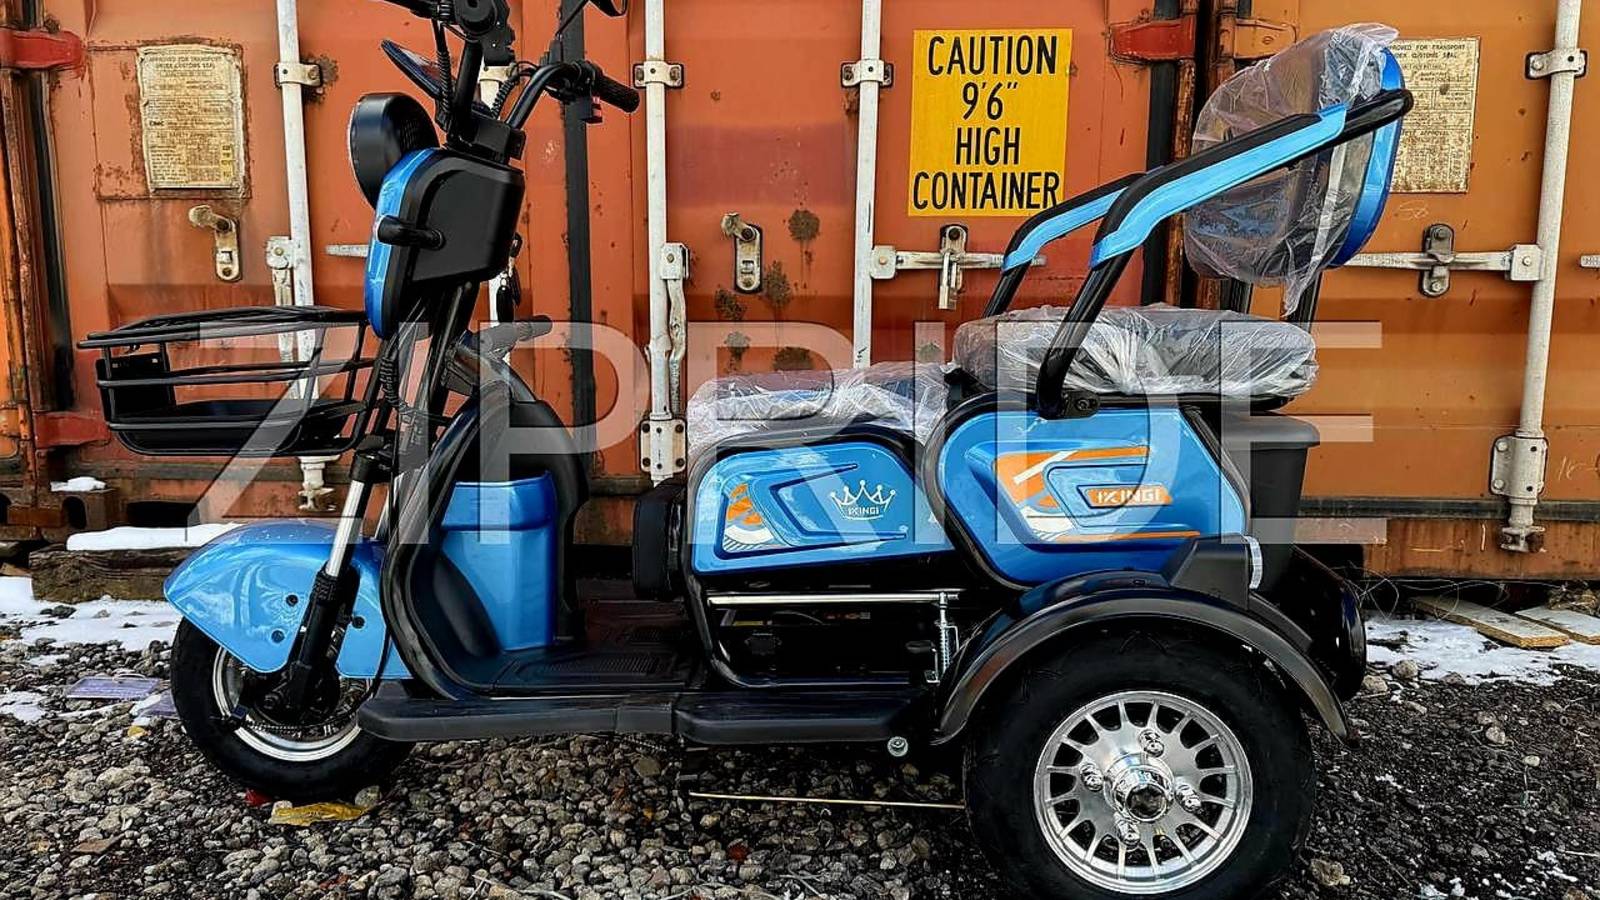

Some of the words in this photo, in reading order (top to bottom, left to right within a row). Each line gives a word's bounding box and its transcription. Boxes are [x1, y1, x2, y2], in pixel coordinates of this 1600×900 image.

[928, 35, 1057, 75] CAUTION
[956, 127, 1021, 165] HIGH
[913, 171, 1060, 210] CONTAINER
